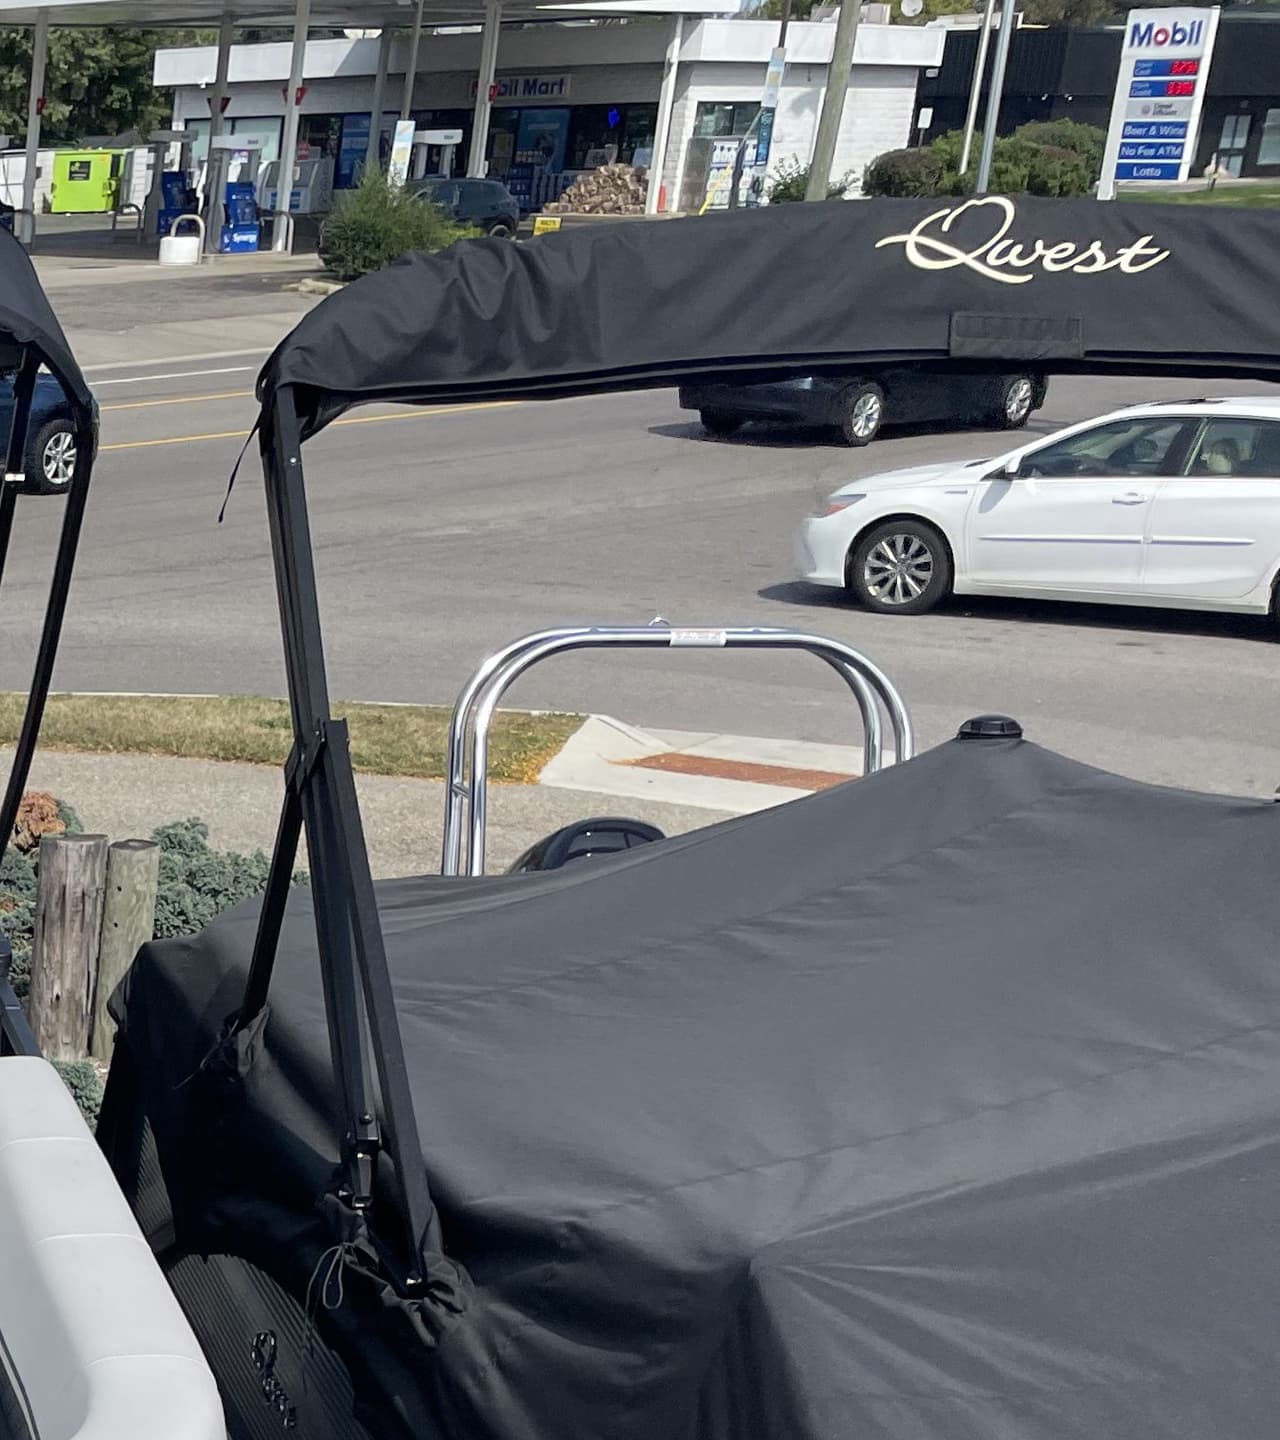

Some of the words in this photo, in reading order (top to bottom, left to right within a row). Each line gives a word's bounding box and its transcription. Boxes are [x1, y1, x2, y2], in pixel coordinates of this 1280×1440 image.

[1129, 19, 1203, 48] Mobil
[522, 77, 565, 97] Mart
[1120, 146, 1136, 156] No
[1157, 145, 1182, 156] ATM
[1133, 166, 1162, 177] Lotto
[874, 196, 1171, 285] Qwest
